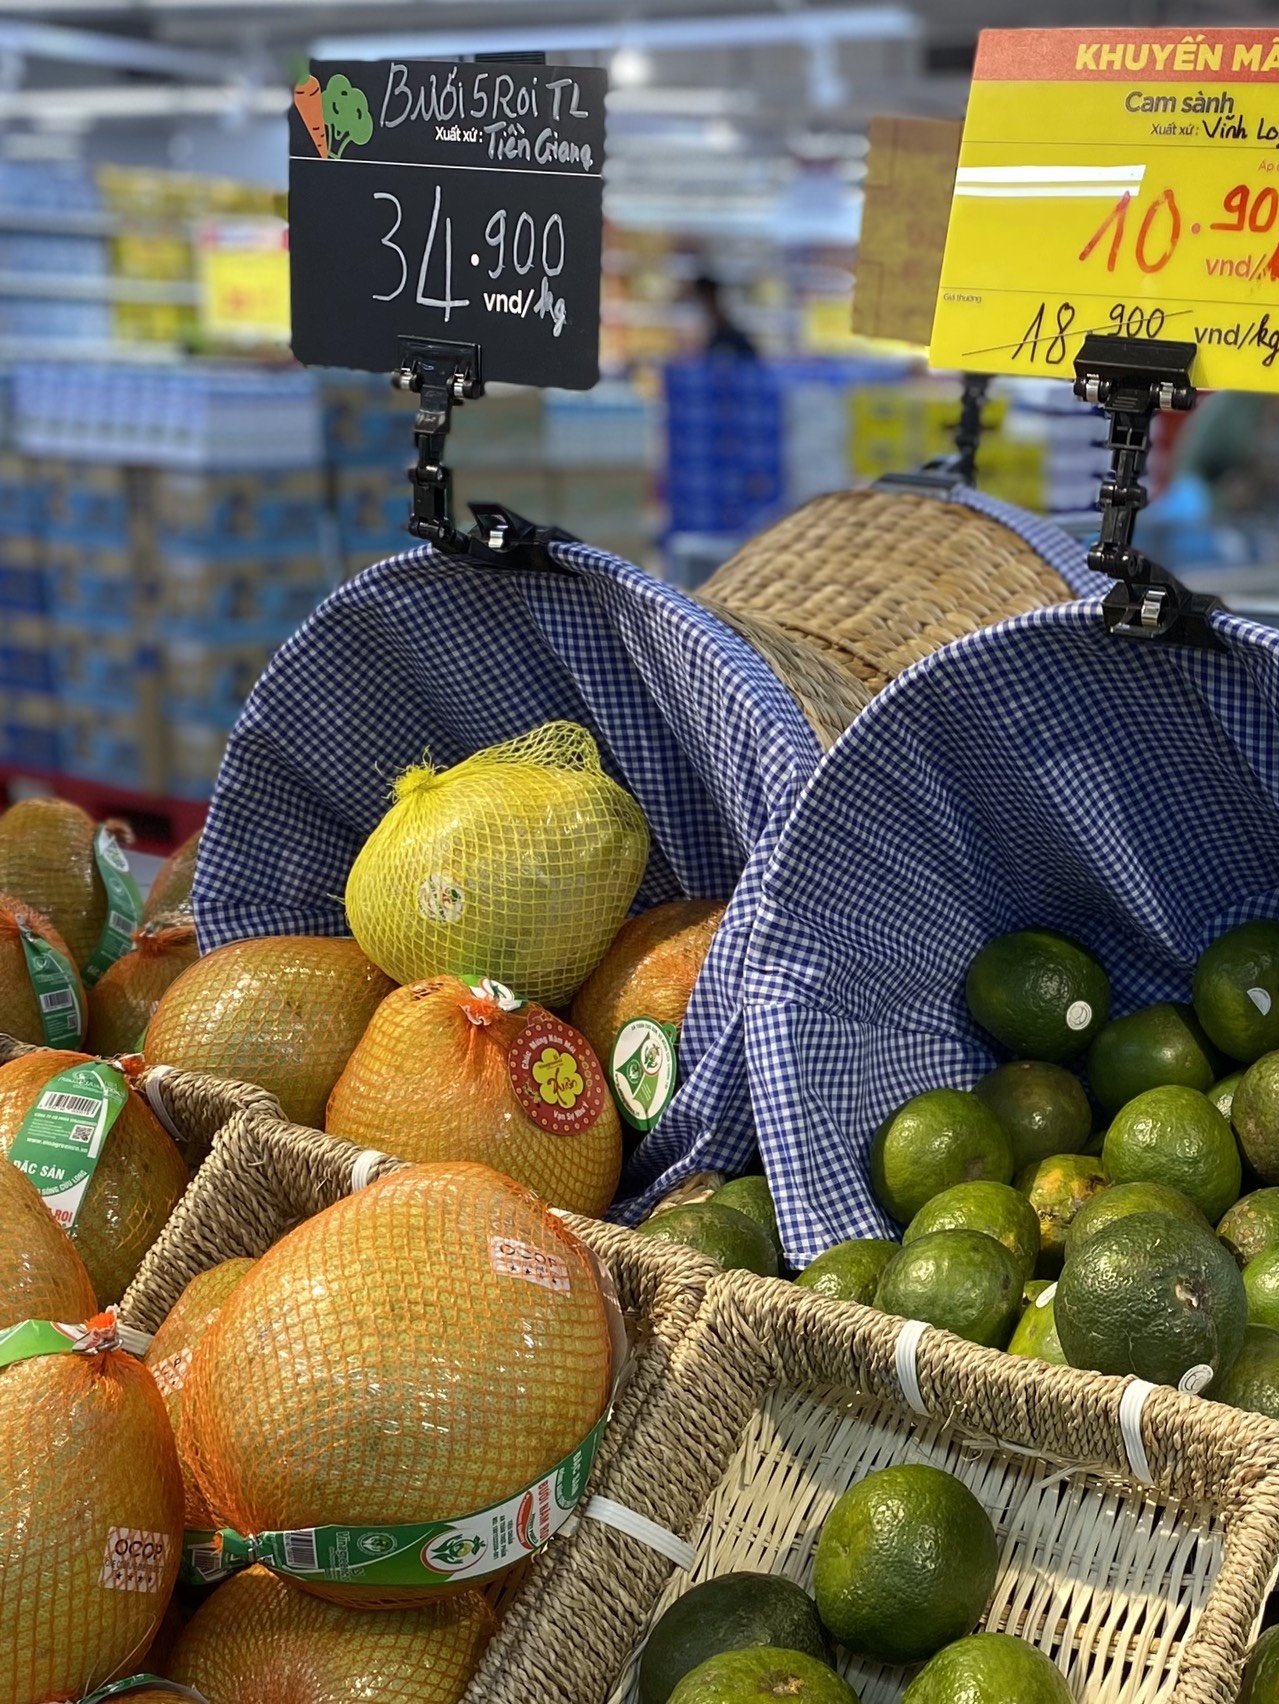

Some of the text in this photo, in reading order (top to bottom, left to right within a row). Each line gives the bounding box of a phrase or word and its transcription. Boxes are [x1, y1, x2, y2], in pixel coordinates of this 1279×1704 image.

[1075, 34, 1224, 71] KHUYẾN
[545, 79, 589, 120] TL
[1125, 90, 1234, 113] Cam sành
[1150, 121, 1177, 136] Xuất
[1202, 114, 1247, 139] Vĩnh
[435, 125, 461, 142] Xuất
[483, 121, 531, 162] Tiền
[1258, 160, 1274, 172] Áp
[40, 1164, 65, 1180] SẢN
